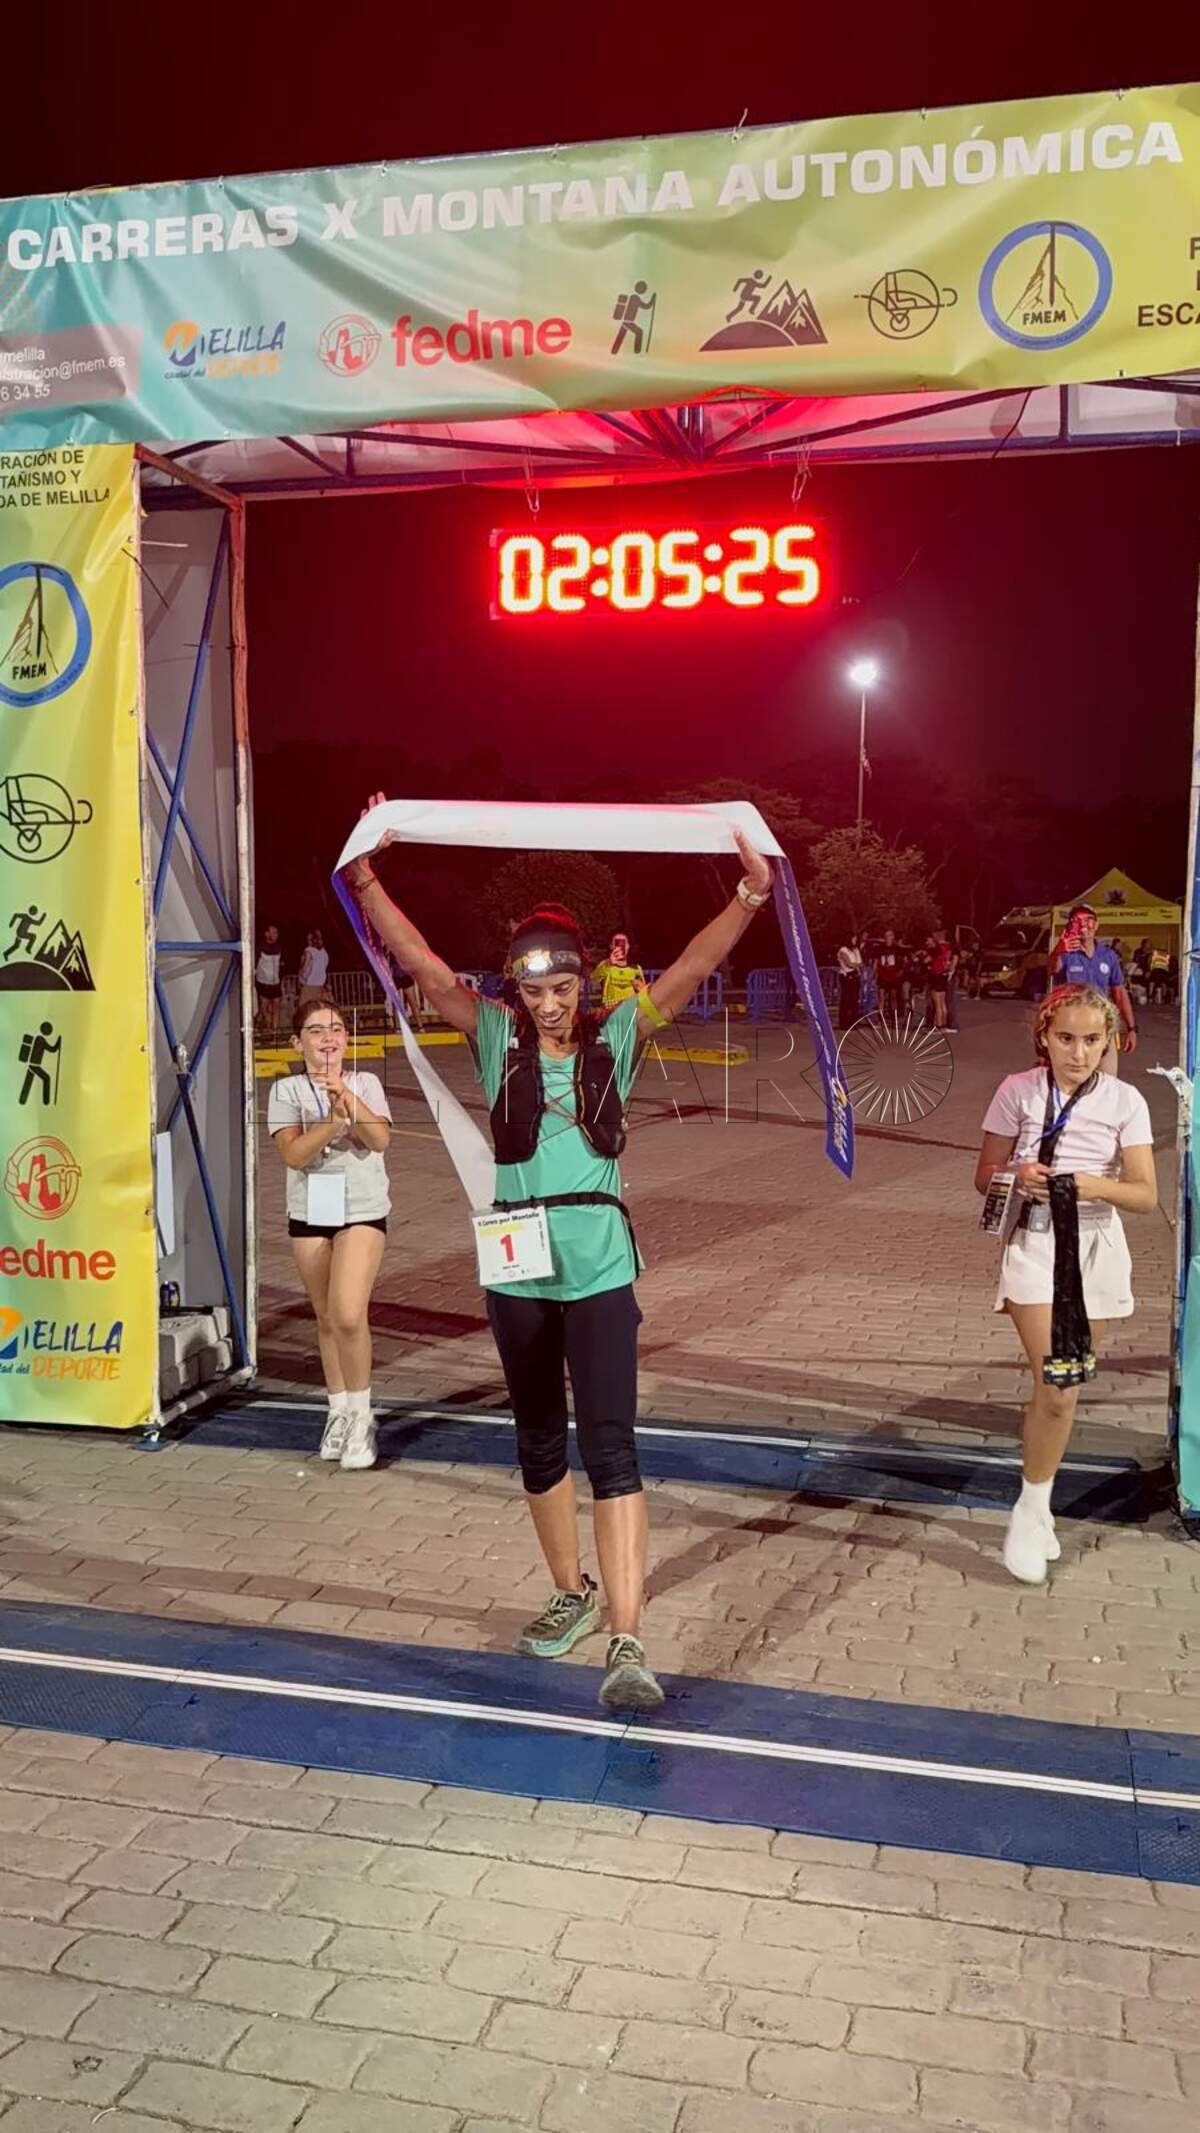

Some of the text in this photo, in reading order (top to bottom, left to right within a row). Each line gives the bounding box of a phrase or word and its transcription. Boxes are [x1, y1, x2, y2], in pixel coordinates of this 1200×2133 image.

[7, 121, 1183, 271] CARRERAS X MONTAÑA AUTONÓMICA
[1022, 309, 1067, 326] FMEM
[1138, 303, 1200, 328] ESC
[392, 308, 573, 367] fedme
[13, 385, 31, 400] 34
[34, 383, 51, 398] 55
[62, 449, 84, 464] DE
[0, 469, 81, 488] TAÑISMO Y
[21, 492, 41, 507] DE
[46, 488, 110, 505] MELILLA
[500, 525, 819, 613] 02:05:25
[12, 663, 47, 680] FMEM
[0, 1239, 117, 1281] edme
[500, 1234, 514, 1262] 1
[32, 1356, 122, 1381] DEPORTE
